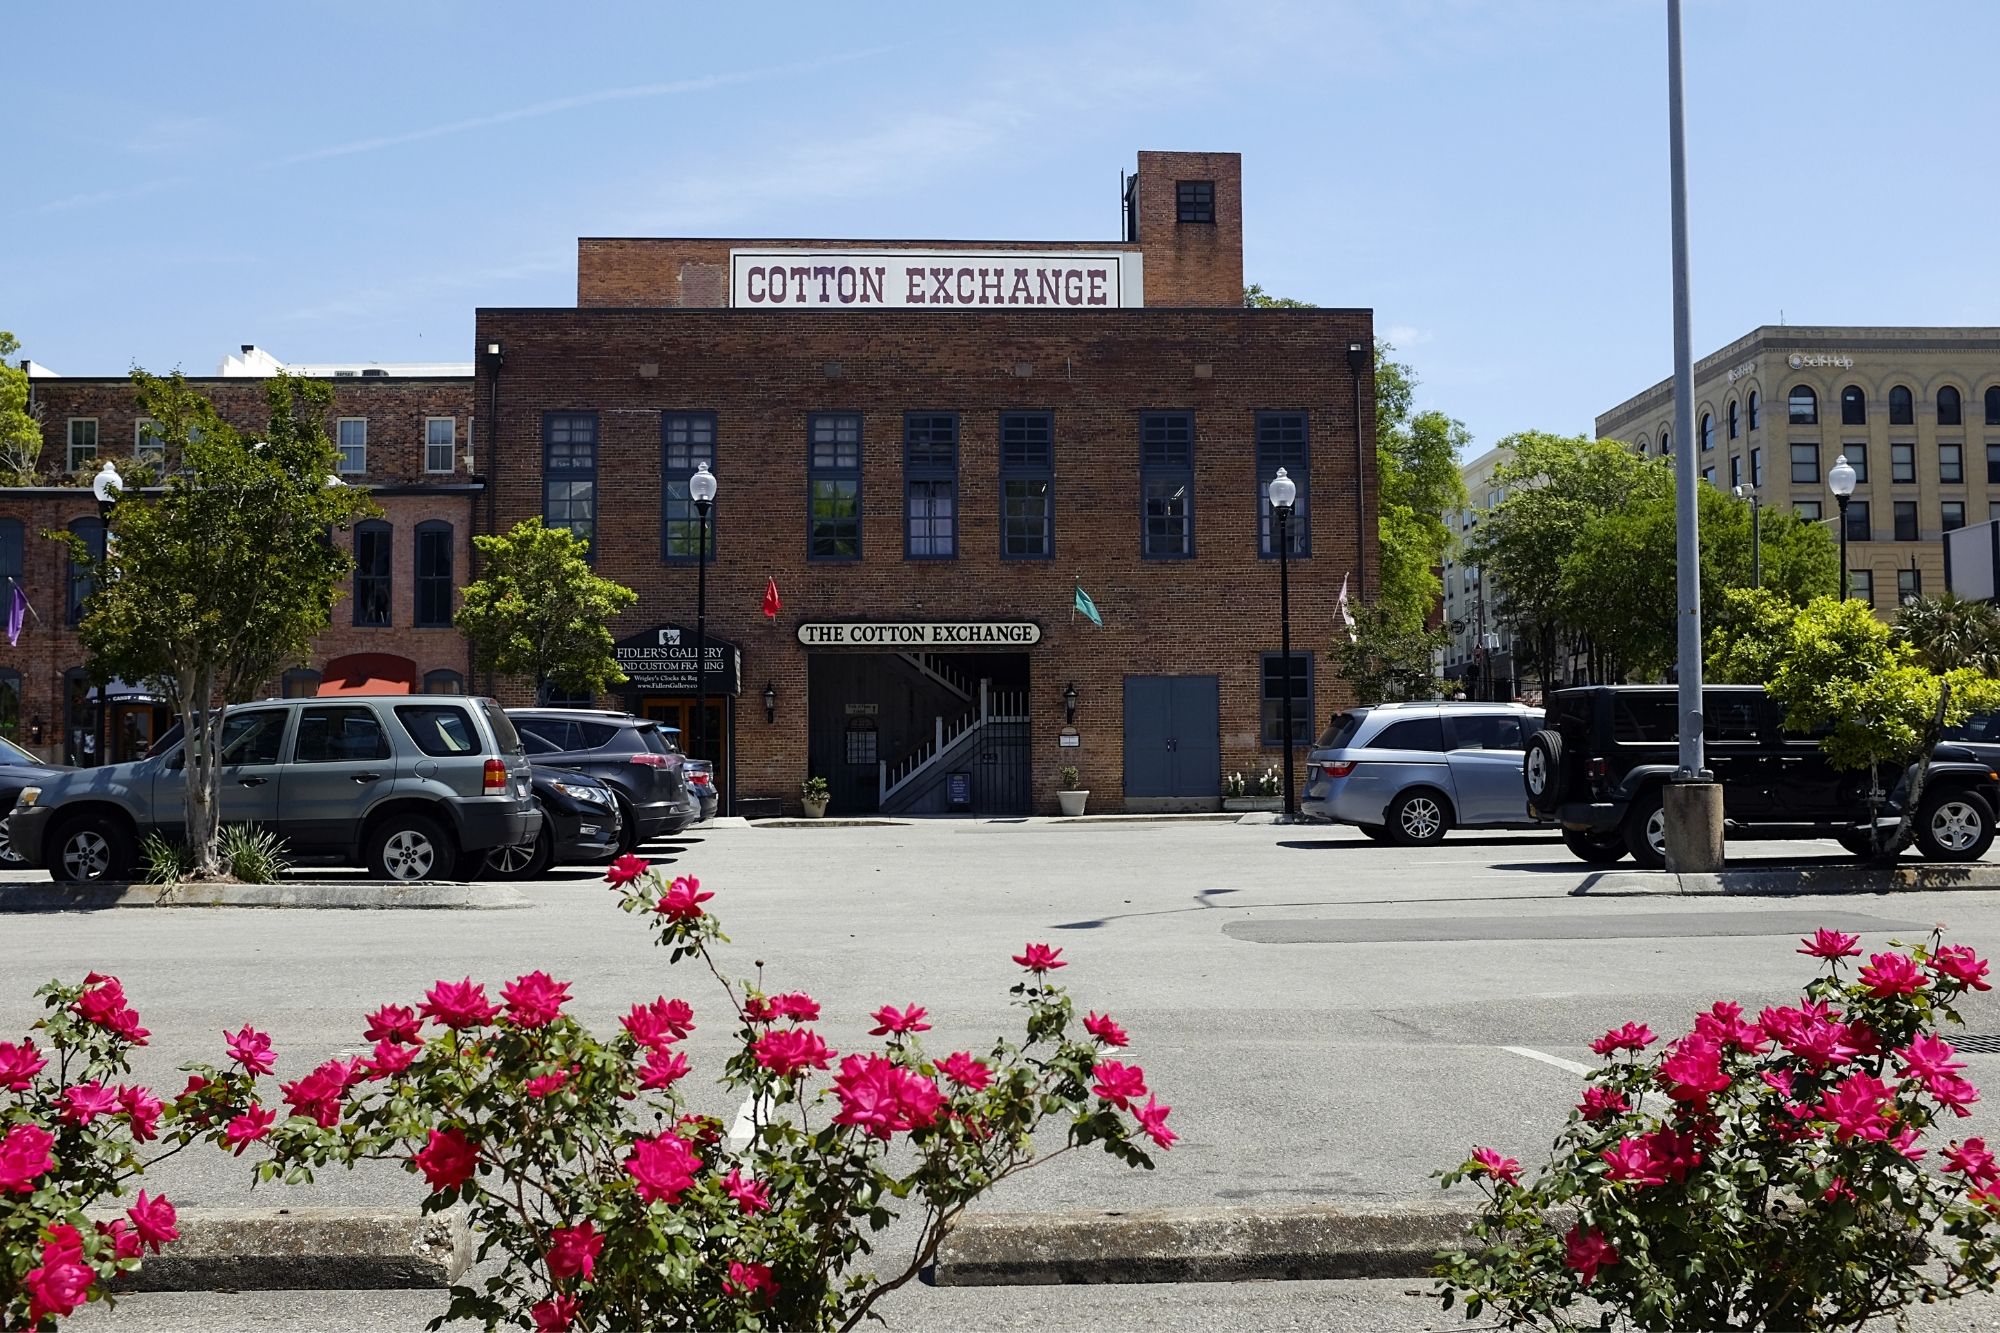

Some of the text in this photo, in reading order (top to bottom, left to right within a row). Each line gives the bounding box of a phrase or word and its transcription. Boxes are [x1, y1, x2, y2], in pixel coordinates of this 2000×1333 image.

[747, 265, 1108, 305] COTTON EXCHANGE
[1803, 355, 1853, 370] Self-Help
[806, 625, 1032, 641] THE COTTON EXCHANGE
[617, 647, 668, 658] FIDLER'S
[639, 662, 679, 670] CUSTOM
[681, 662, 724, 670] FRAING
